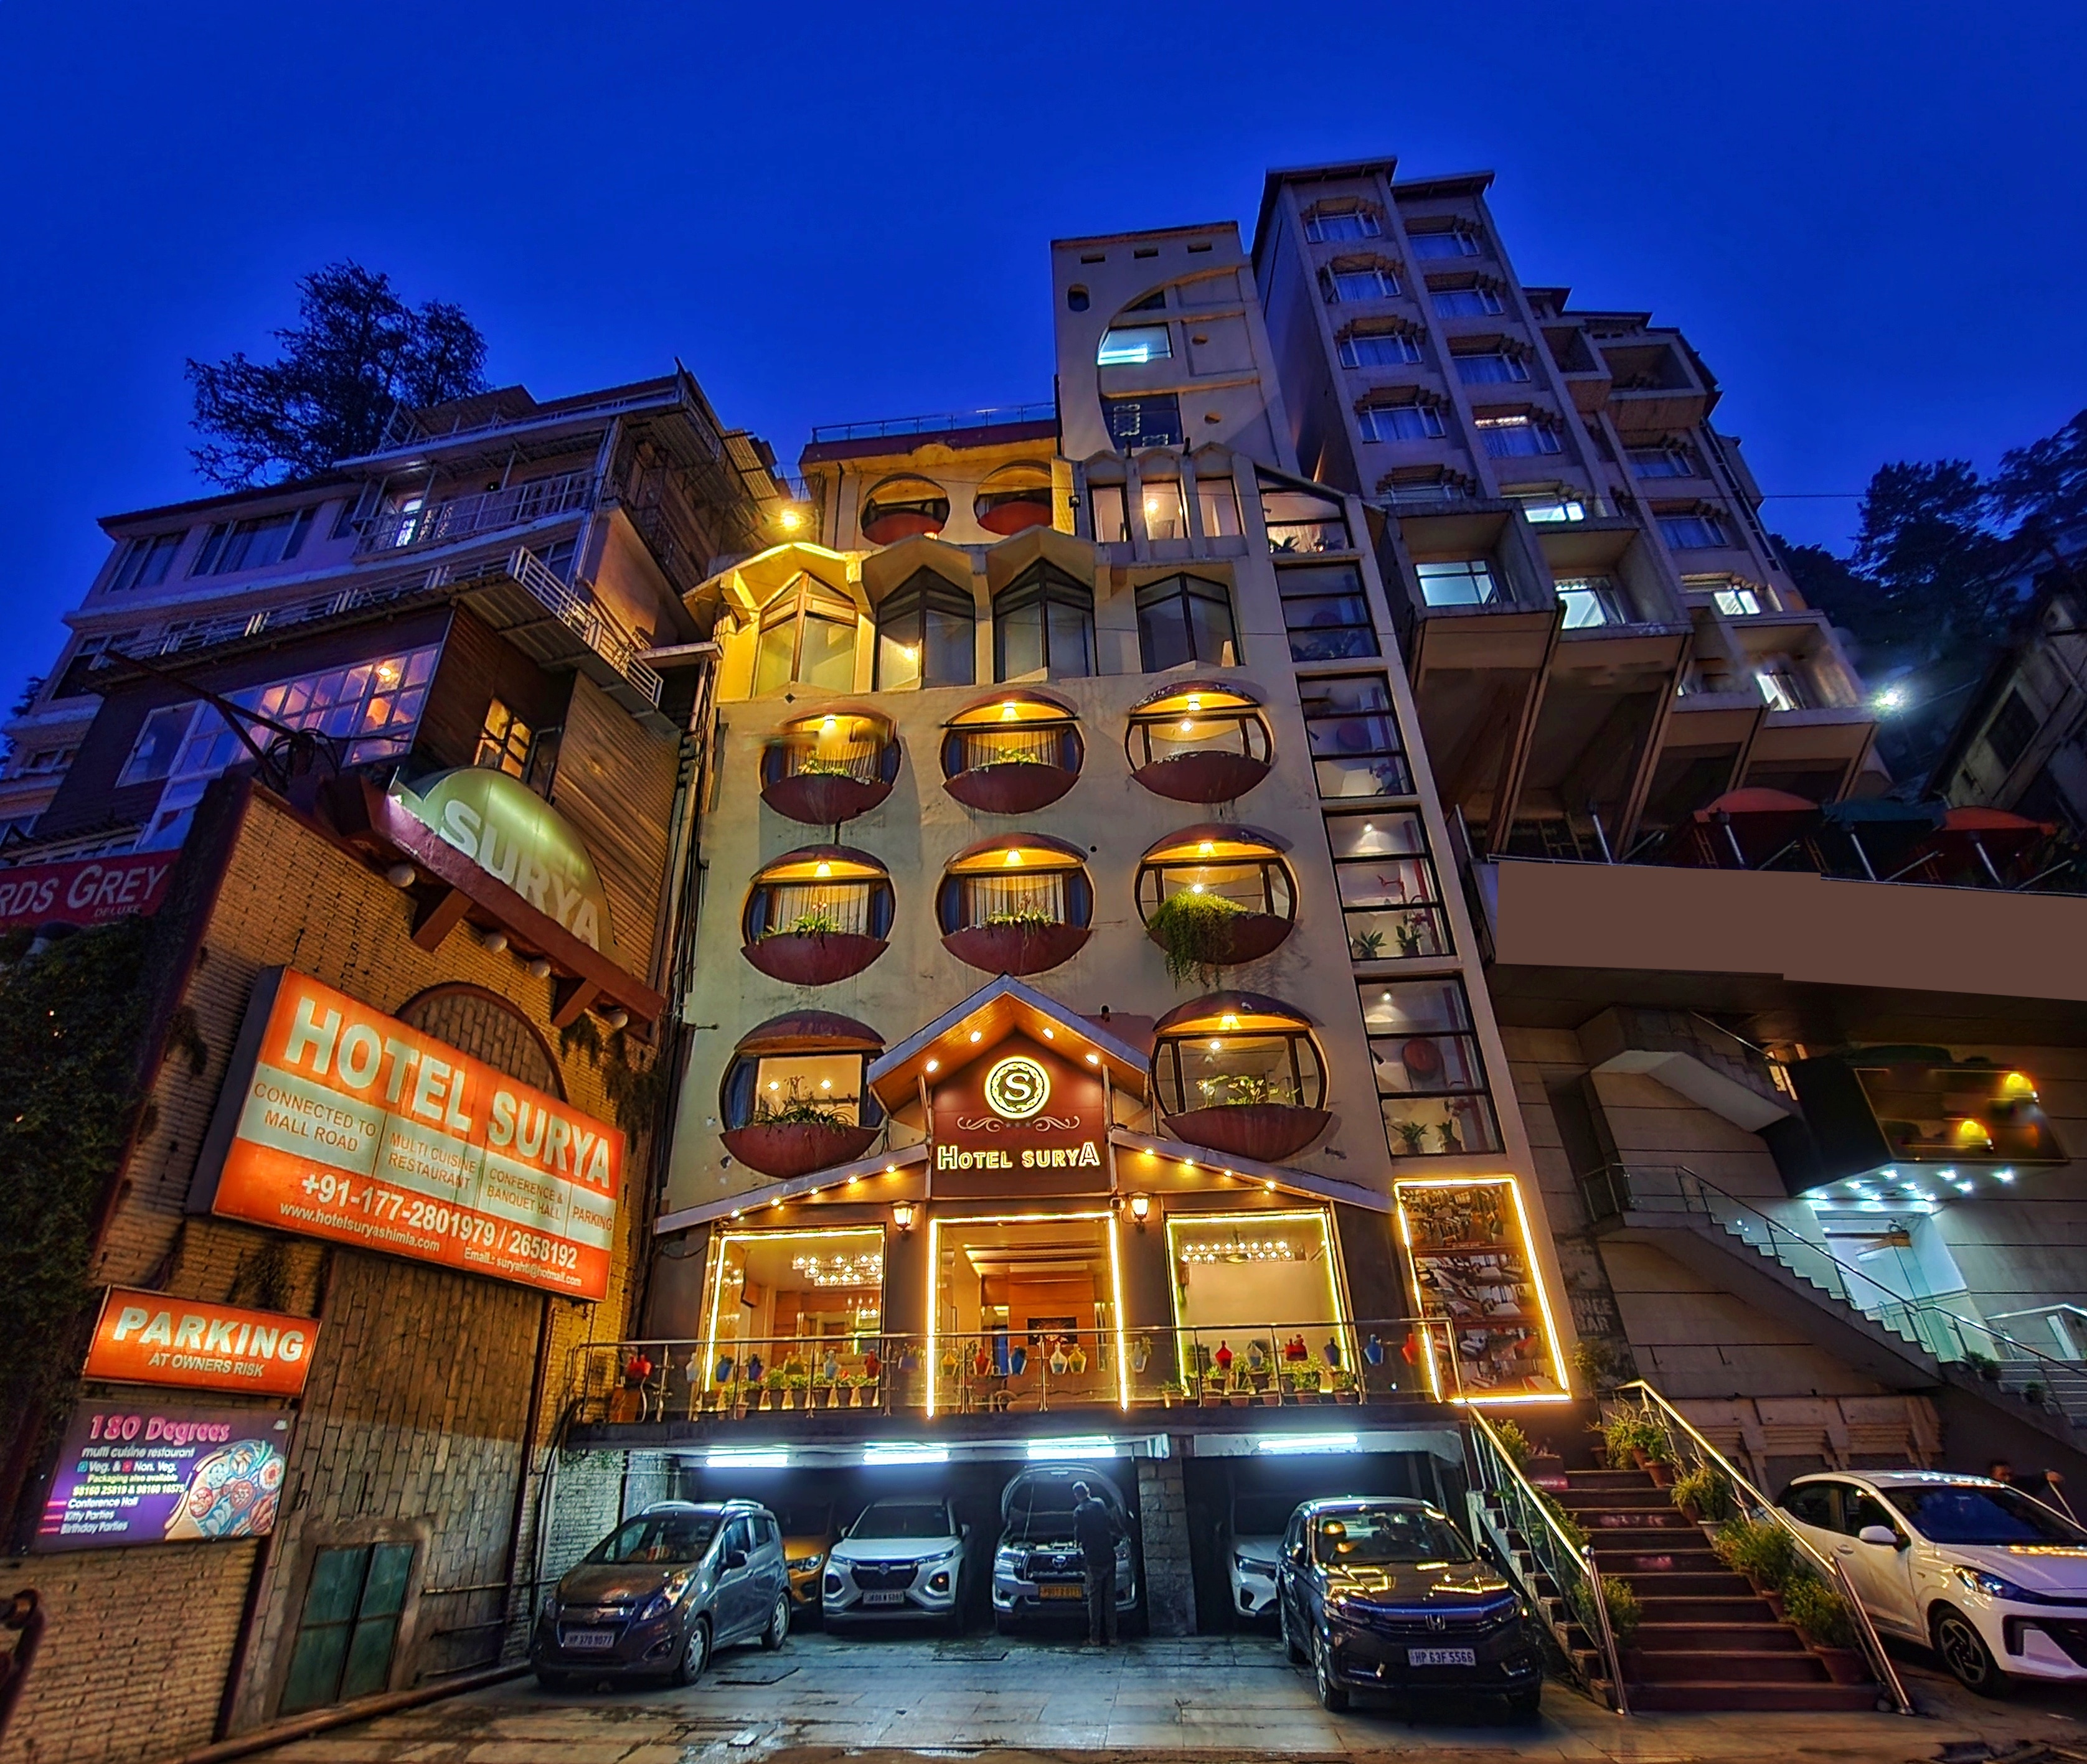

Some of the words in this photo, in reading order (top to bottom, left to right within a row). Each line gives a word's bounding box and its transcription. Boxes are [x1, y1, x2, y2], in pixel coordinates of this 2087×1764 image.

[67, 864, 169, 909] GREY
[439, 799, 600, 952] SURYA
[93, 904, 143, 917] DELUXE
[283, 996, 473, 1133] HOTEL
[488, 1091, 611, 1189] SURYA
[1004, 1072, 1031, 1100] S
[254, 1082, 354, 1129] CONNECTED
[358, 1119, 376, 1137] TO
[265, 1109, 309, 1138] MALL
[314, 1127, 359, 1152] ROAD
[389, 1132, 427, 1155] MULTI
[431, 1147, 476, 1174] CUISINE
[937, 1145, 1013, 1171] HOTEL
[1021, 1142, 1100, 1168] SURYA
[388, 1153, 471, 1190] RESTAURANT
[489, 1168, 555, 1202] CONFERENCE
[557, 1193, 563, 1204] &
[486, 1185, 536, 1211] BANQUET
[537, 1201, 560, 1221] HALL
[280, 1202, 440, 1252] www.hotelsuryashimla.com
[301, 1173, 496, 1247] +91-177-2801979
[497, 1225, 507, 1250] /
[508, 1229, 577, 1270] 2658192
[572, 1205, 613, 1232] PARKING
[113, 1306, 305, 1362] PARKING
[148, 1352, 171, 1367] AT
[172, 1354, 232, 1374] OWNERS
[232, 1361, 265, 1377] RISK
[90, 1414, 141, 1440] 180
[144, 1416, 230, 1446] Degrees
[88, 1461, 110, 1473] Veg.
[113, 1460, 121, 1471] &
[158, 1461, 177, 1473] Veg.
[111, 1445, 146, 1458] cuisine
[147, 1446, 196, 1458] restaurant
[87, 1473, 128, 1484] Packaging
[129, 1474, 146, 1482] also
[146, 1473, 178, 1482] available
[127, 1485, 135, 1494] &
[68, 1497, 121, 1509] Conference
[121, 1496, 139, 1508] Hall
[85, 1510, 115, 1521] Parties
[60, 1522, 99, 1535] Birthday
[98, 1521, 129, 1532] Parties
[1415, 1651, 1427, 1663] HP
[1449, 1651, 1473, 1663] 5566
